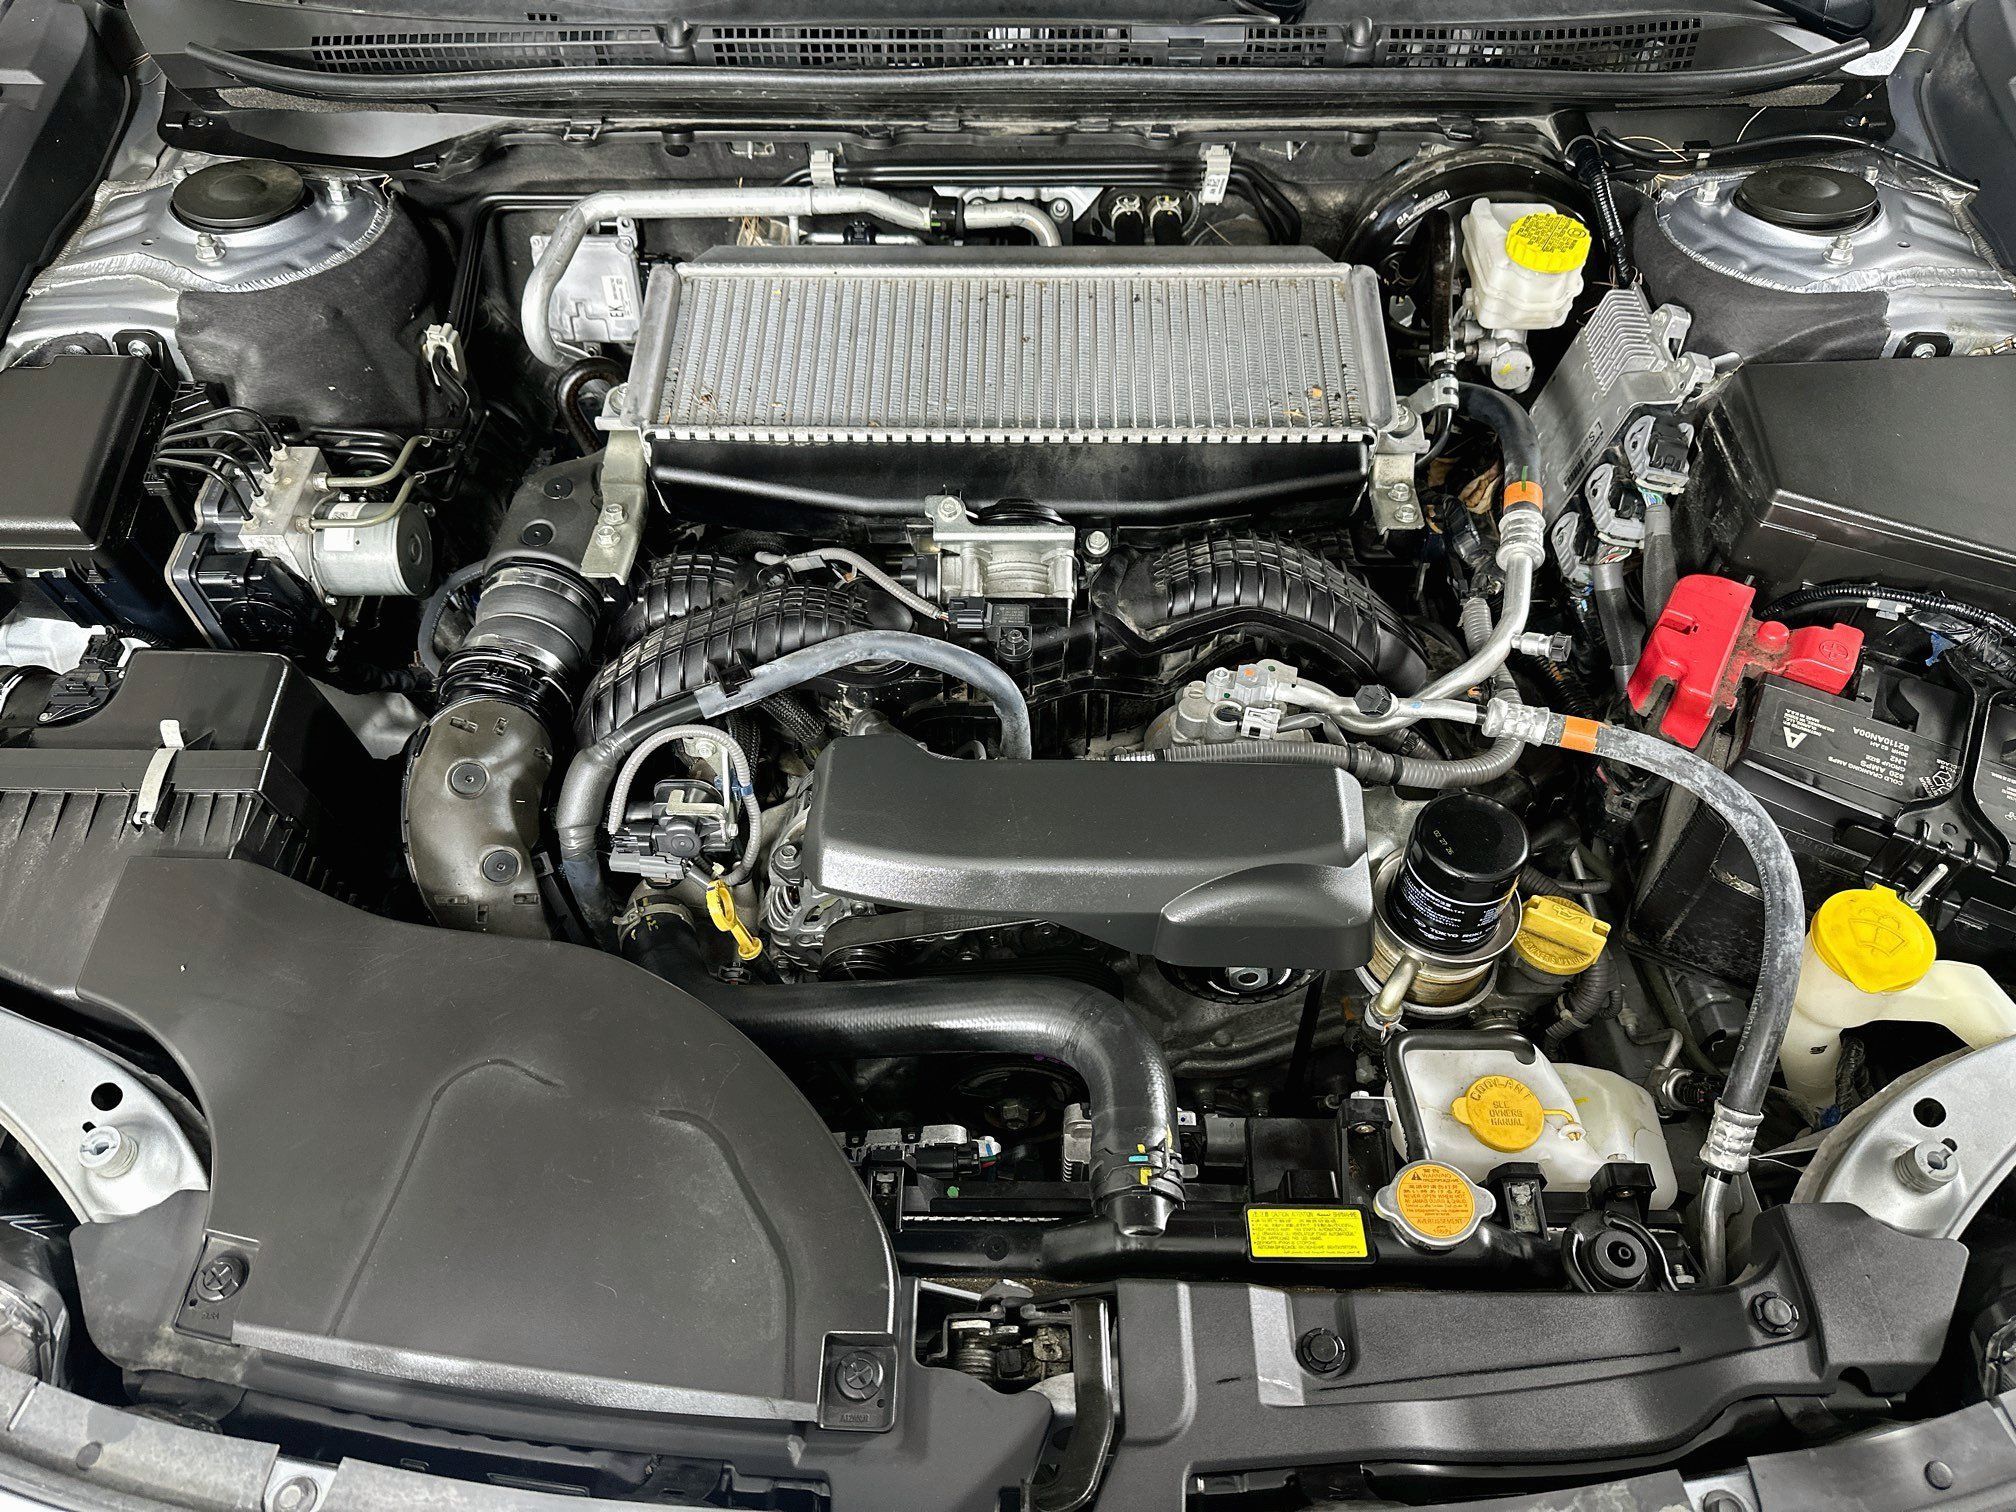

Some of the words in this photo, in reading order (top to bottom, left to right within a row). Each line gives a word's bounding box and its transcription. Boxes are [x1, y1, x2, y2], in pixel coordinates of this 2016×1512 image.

[608, 305, 624, 318] EK
[1783, 727, 1807, 749] A
[1853, 727, 1910, 751] 82110AN00A
[1865, 753, 1880, 763] SIZE
[1891, 748, 1908, 757] 20HR
[1828, 756, 1848, 766] AMPS
[1890, 755, 1907, 766] LN2
[1848, 763, 1883, 779] CRANKING
[1860, 760, 1886, 773] AMPS
[1881, 761, 1905, 772] GROUP
[1884, 774, 1903, 786] COLD
[1889, 770, 1904, 780] 620
[1433, 829, 1441, 838] 02
[1430, 927, 1459, 938] TOKYO
[1558, 955, 1586, 965] MANUAL
[1470, 1077, 1534, 1101] COOLANT
[1493, 1101, 1510, 1109] SEE
[1489, 1109, 1523, 1117] OWNERS
[1490, 1118, 1525, 1126] MANUAL
